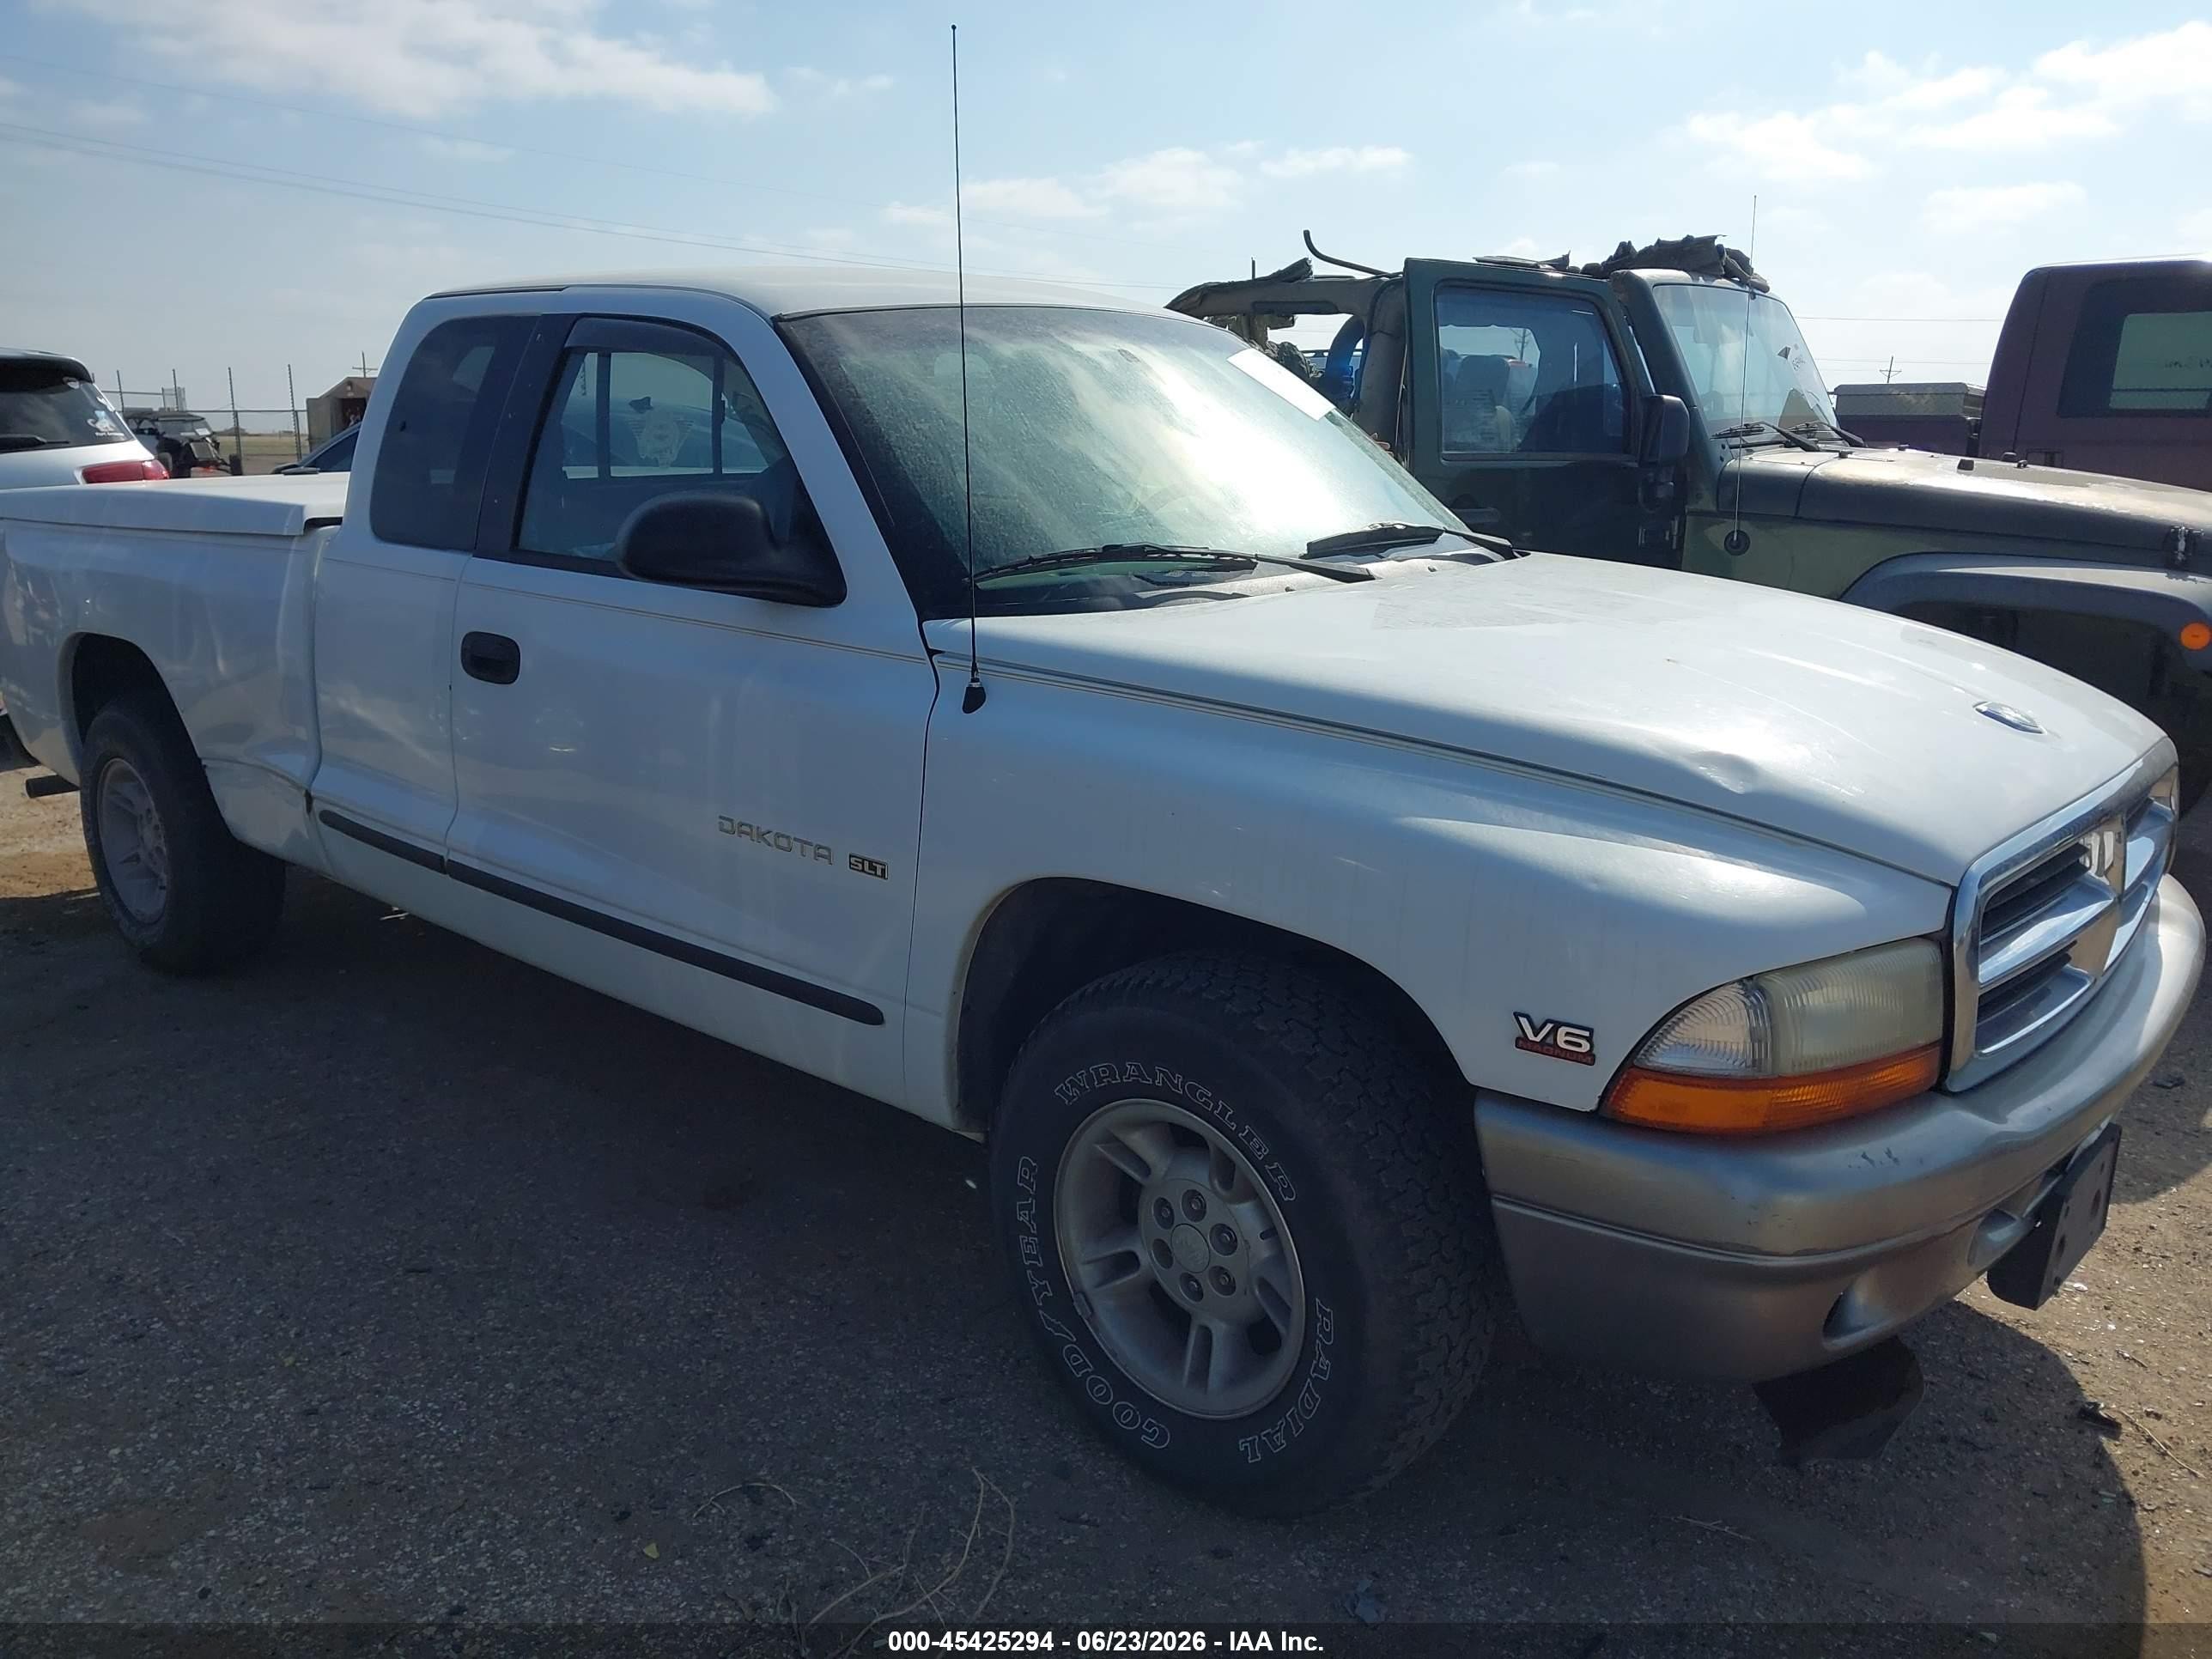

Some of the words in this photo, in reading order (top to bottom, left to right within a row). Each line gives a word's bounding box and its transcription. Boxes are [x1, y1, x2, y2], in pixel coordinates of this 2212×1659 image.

[718, 815, 833, 866] DAKOTA
[849, 854, 887, 878] SLT
[1515, 1013, 1593, 1054] V6
[1054, 1061, 1297, 1201] WRANGLER
[1238, 1297, 1334, 1464] RADIAL
